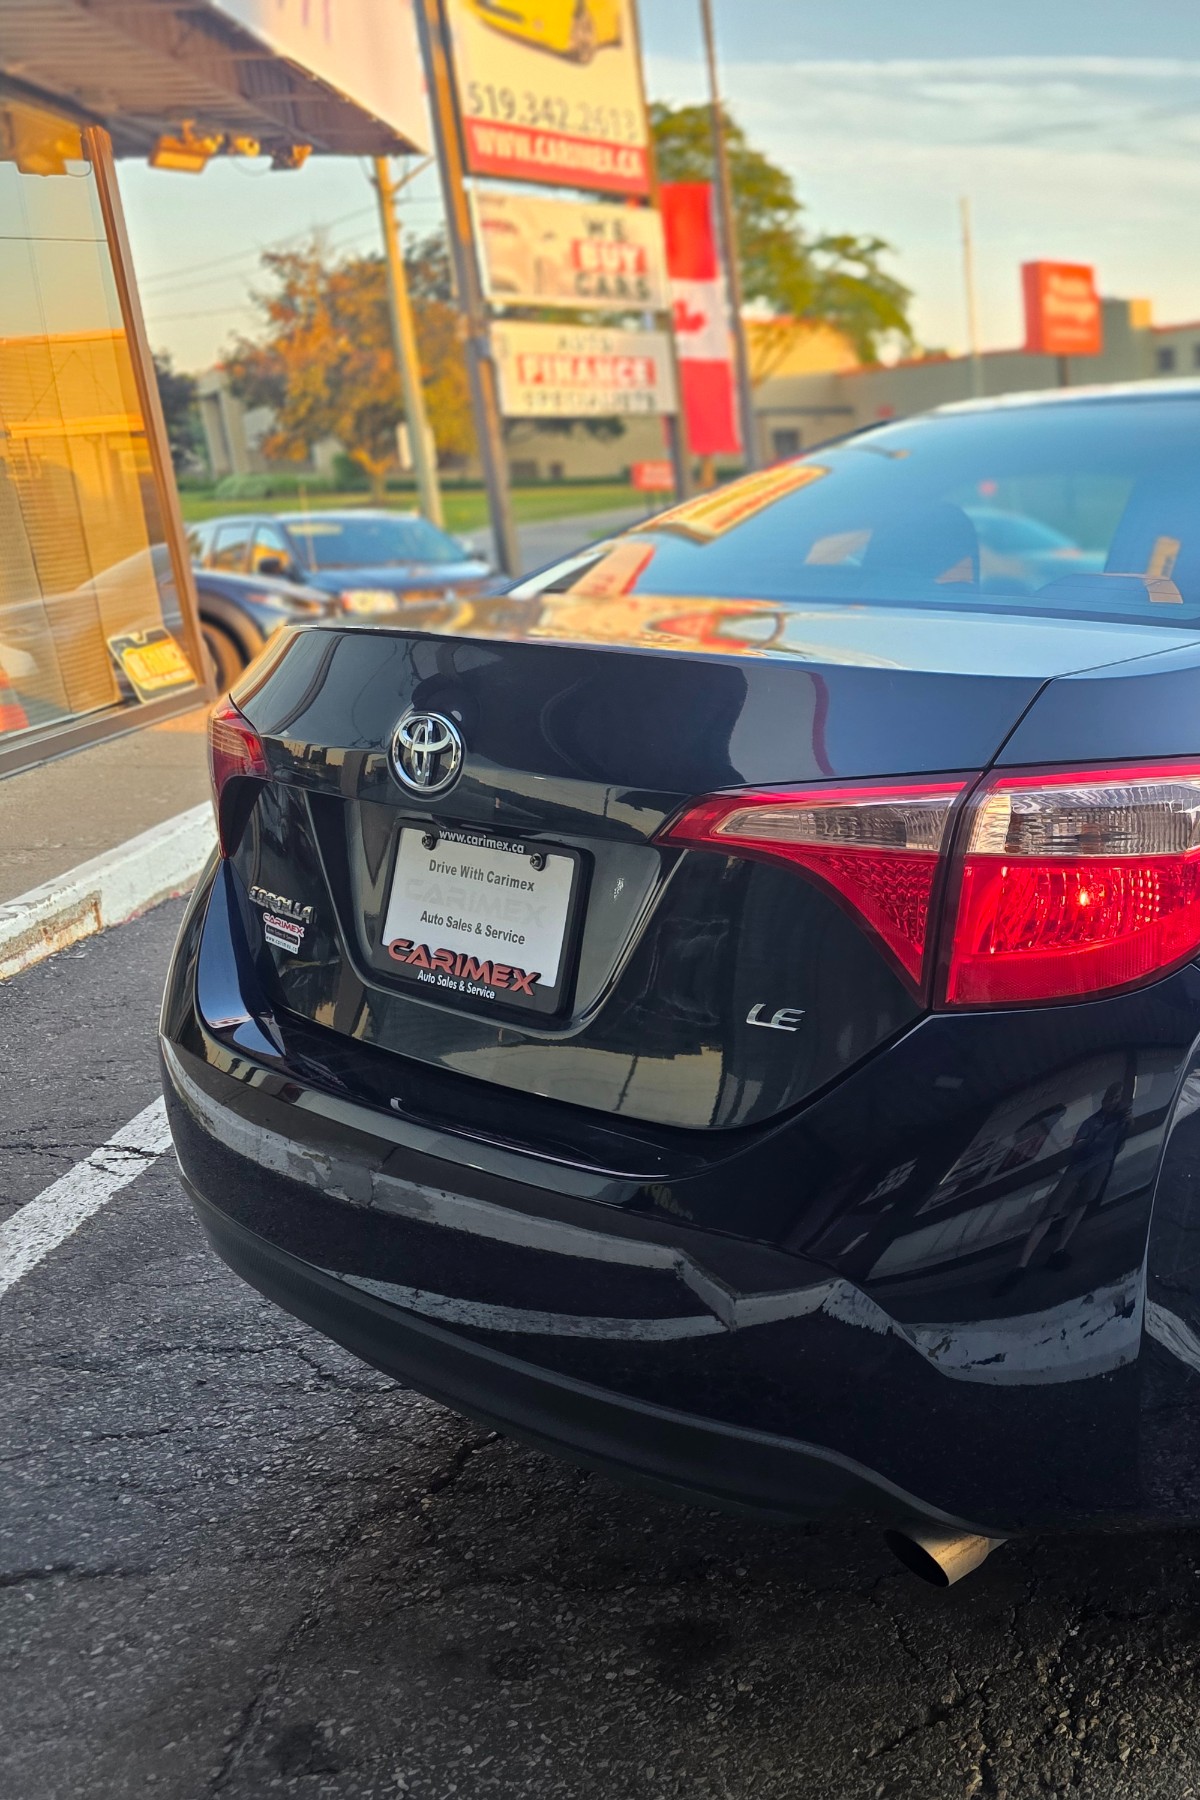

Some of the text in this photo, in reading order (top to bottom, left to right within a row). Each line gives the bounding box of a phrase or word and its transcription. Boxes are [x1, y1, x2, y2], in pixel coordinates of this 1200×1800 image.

[583, 213, 626, 243] WE
[577, 240, 645, 274] BUY
[574, 272, 651, 300] CARS
[522, 354, 649, 387] FINANCE
[439, 829, 525, 854] www.carimex.ca
[429, 858, 535, 892] Drive With Carimex
[263, 914, 304, 936] CARIMEX
[420, 910, 526, 945] Auto Sales & Service
[387, 938, 541, 996] CARIMEX
[417, 969, 496, 1000] Auto Sales & Service
[746, 1003, 806, 1032] LE
